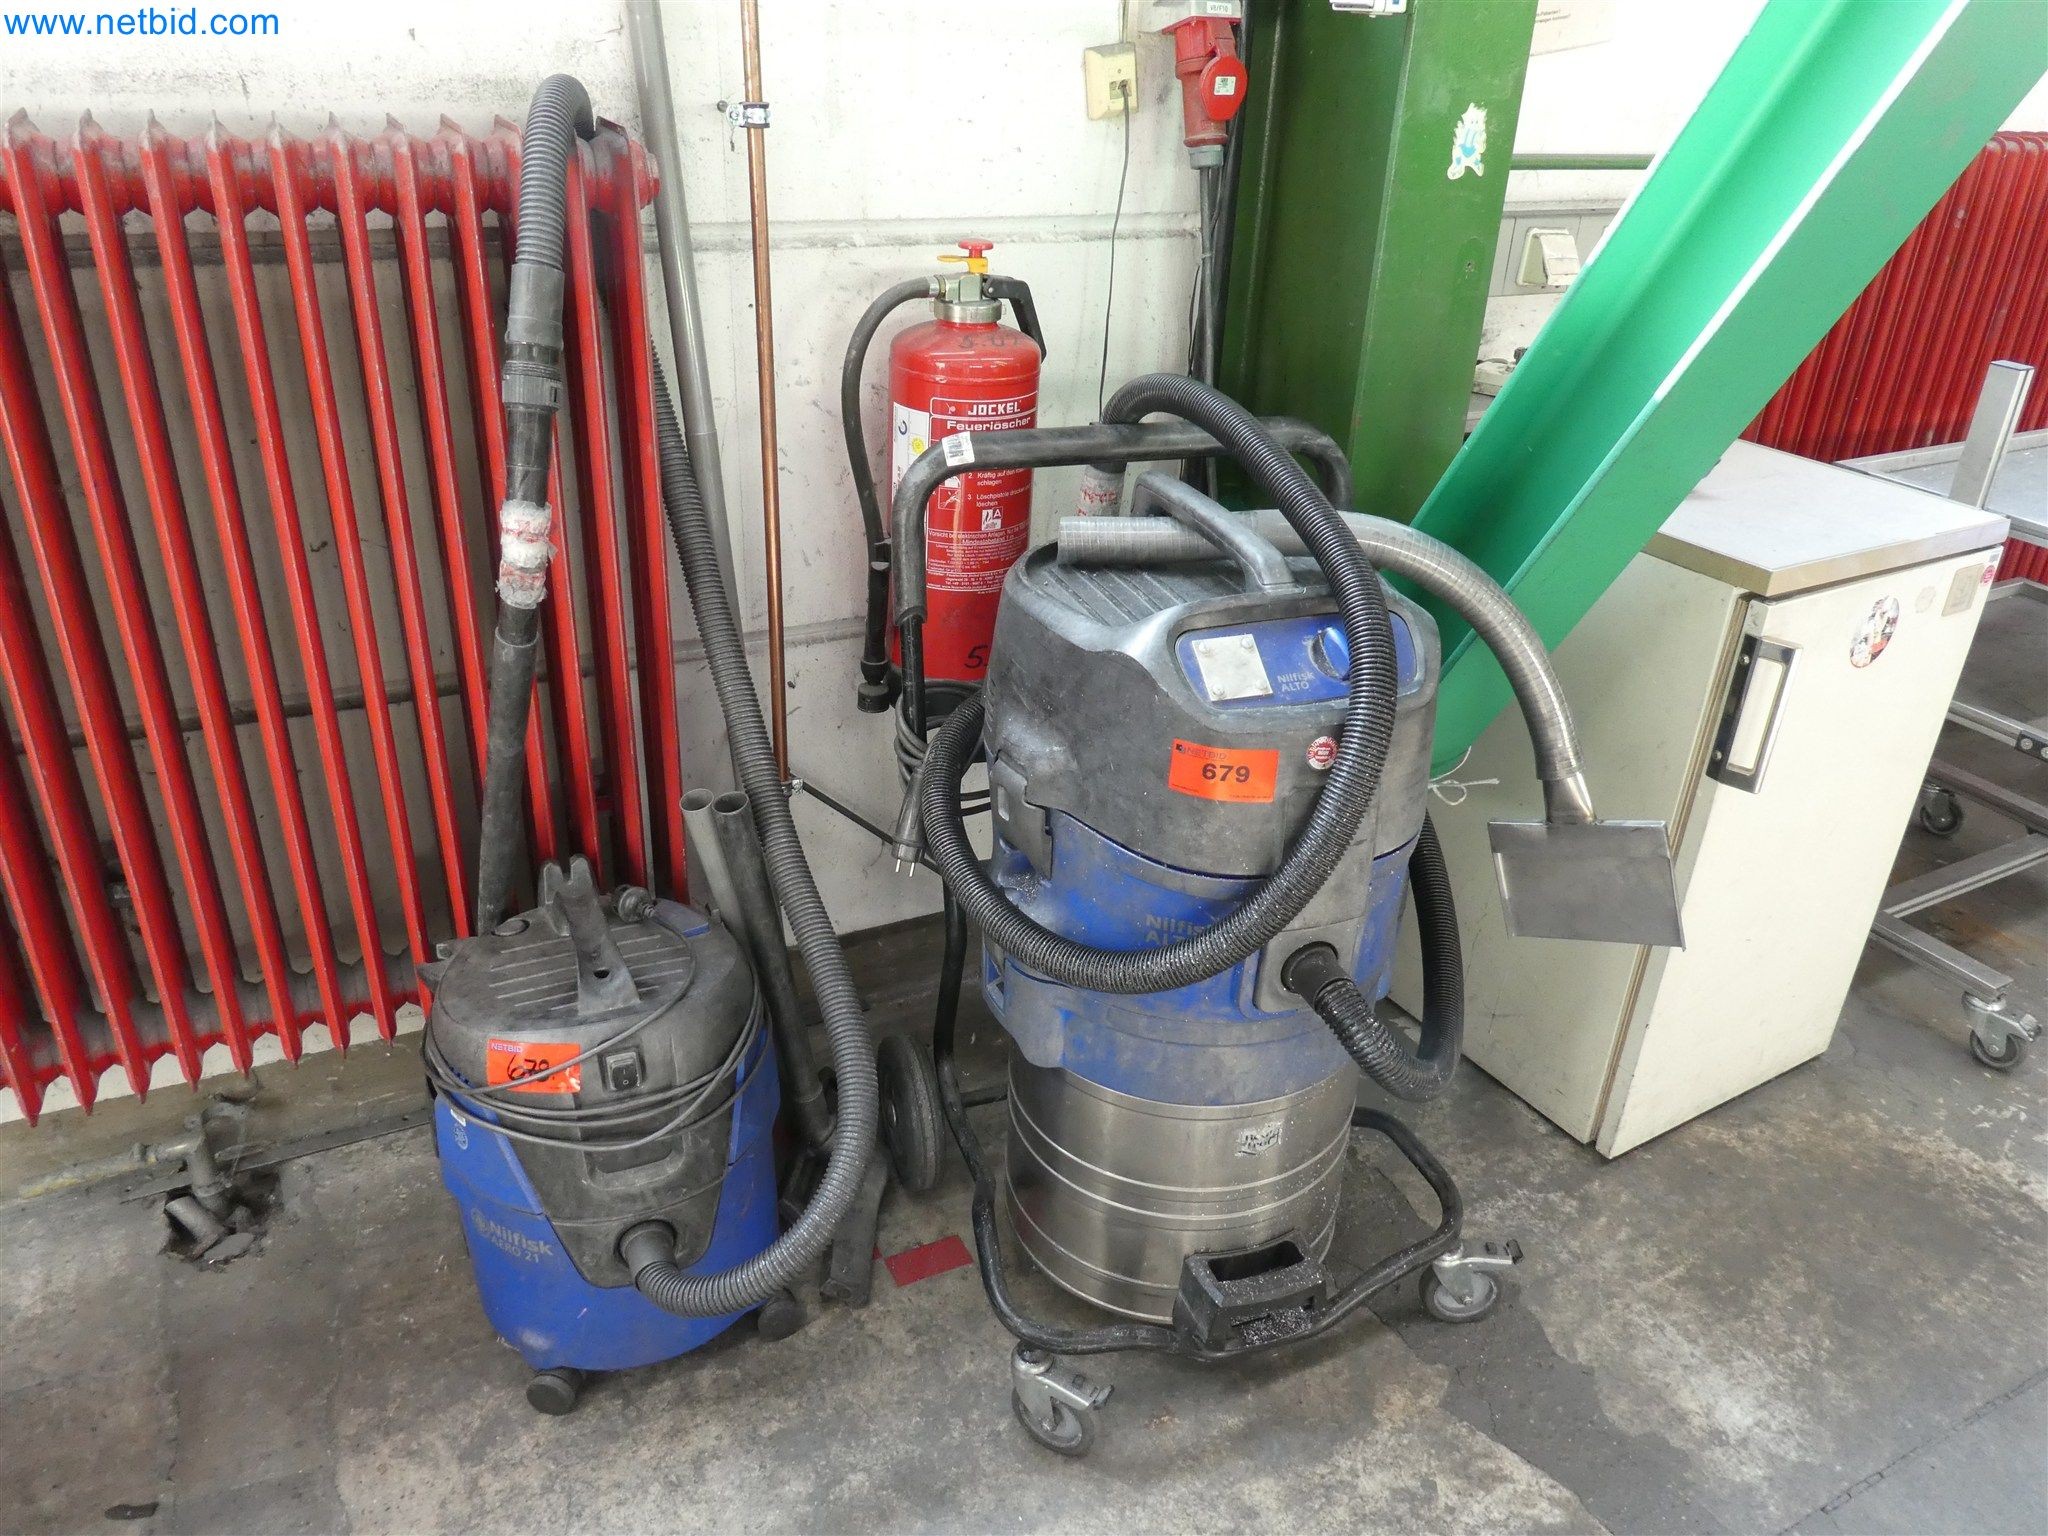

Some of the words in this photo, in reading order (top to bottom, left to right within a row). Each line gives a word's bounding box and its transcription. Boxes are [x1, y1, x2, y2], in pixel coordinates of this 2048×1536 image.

[968, 402, 1021, 416] JOCKEL
[993, 508, 1002, 518] A
[1277, 671, 1316, 682] Nilfisk
[1281, 681, 1310, 691] ALTO
[1186, 747, 1227, 760] NETBID
[1202, 763, 1250, 783] 679
[491, 1043, 523, 1054] NETBID
[489, 1220, 553, 1256] Nilfisk
[524, 1250, 539, 1263] 21
